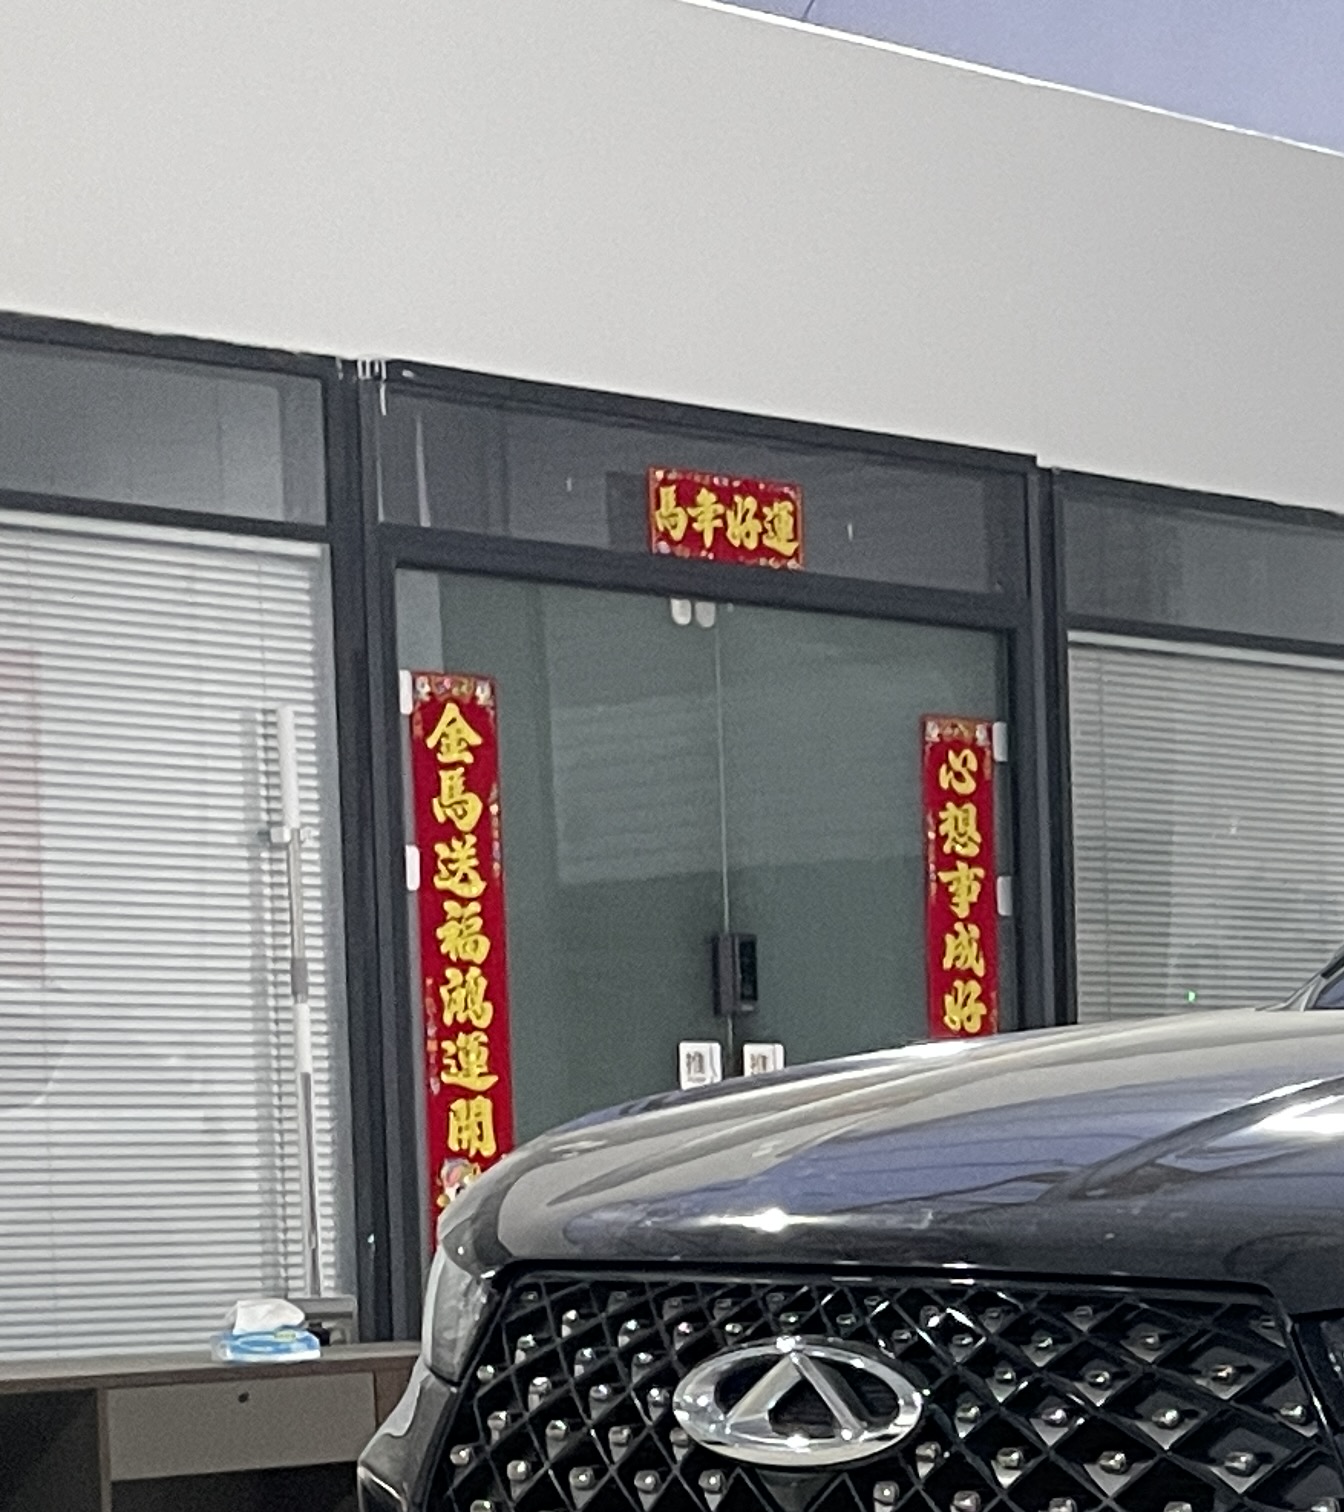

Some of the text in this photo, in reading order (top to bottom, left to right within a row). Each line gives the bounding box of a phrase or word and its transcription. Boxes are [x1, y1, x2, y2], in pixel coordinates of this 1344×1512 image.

[655, 485, 799, 557] 馬年好運
[938, 748, 988, 1034] 心想事成好
